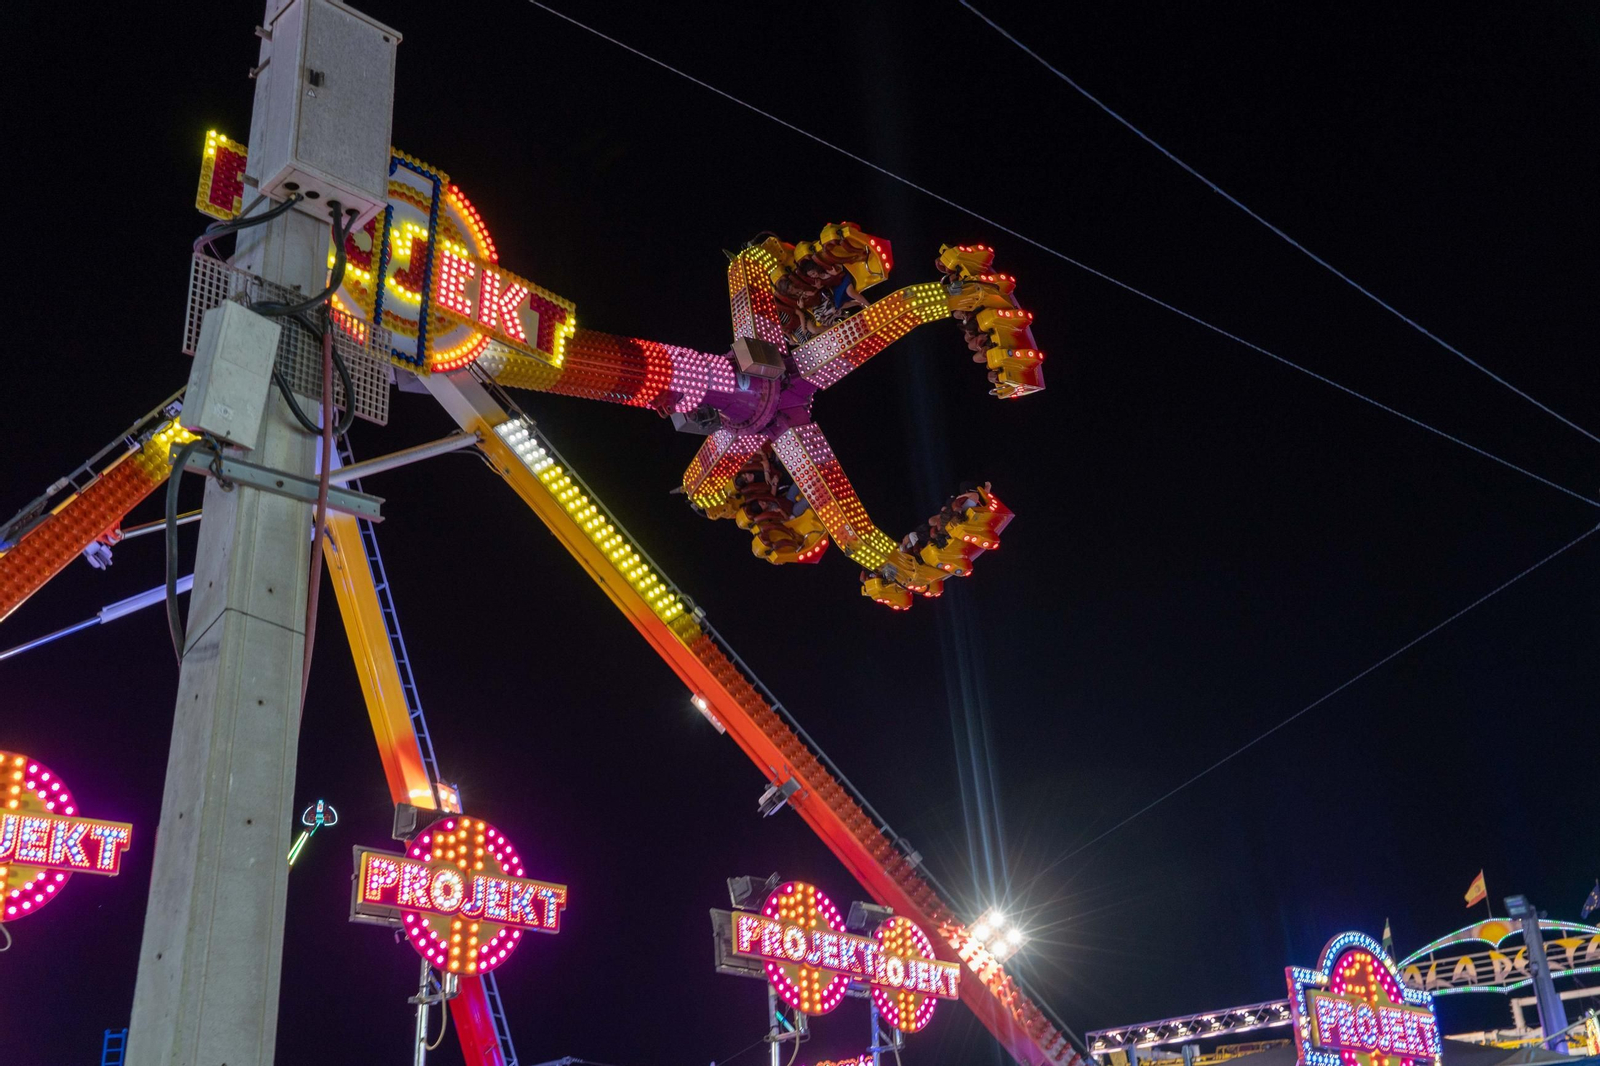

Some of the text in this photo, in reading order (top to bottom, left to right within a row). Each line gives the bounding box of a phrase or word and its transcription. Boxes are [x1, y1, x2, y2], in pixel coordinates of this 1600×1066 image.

[365, 856, 566, 929] PROJEKT
[737, 915, 880, 976] PROJEKT
[1315, 995, 1437, 1058] PROJEKT
